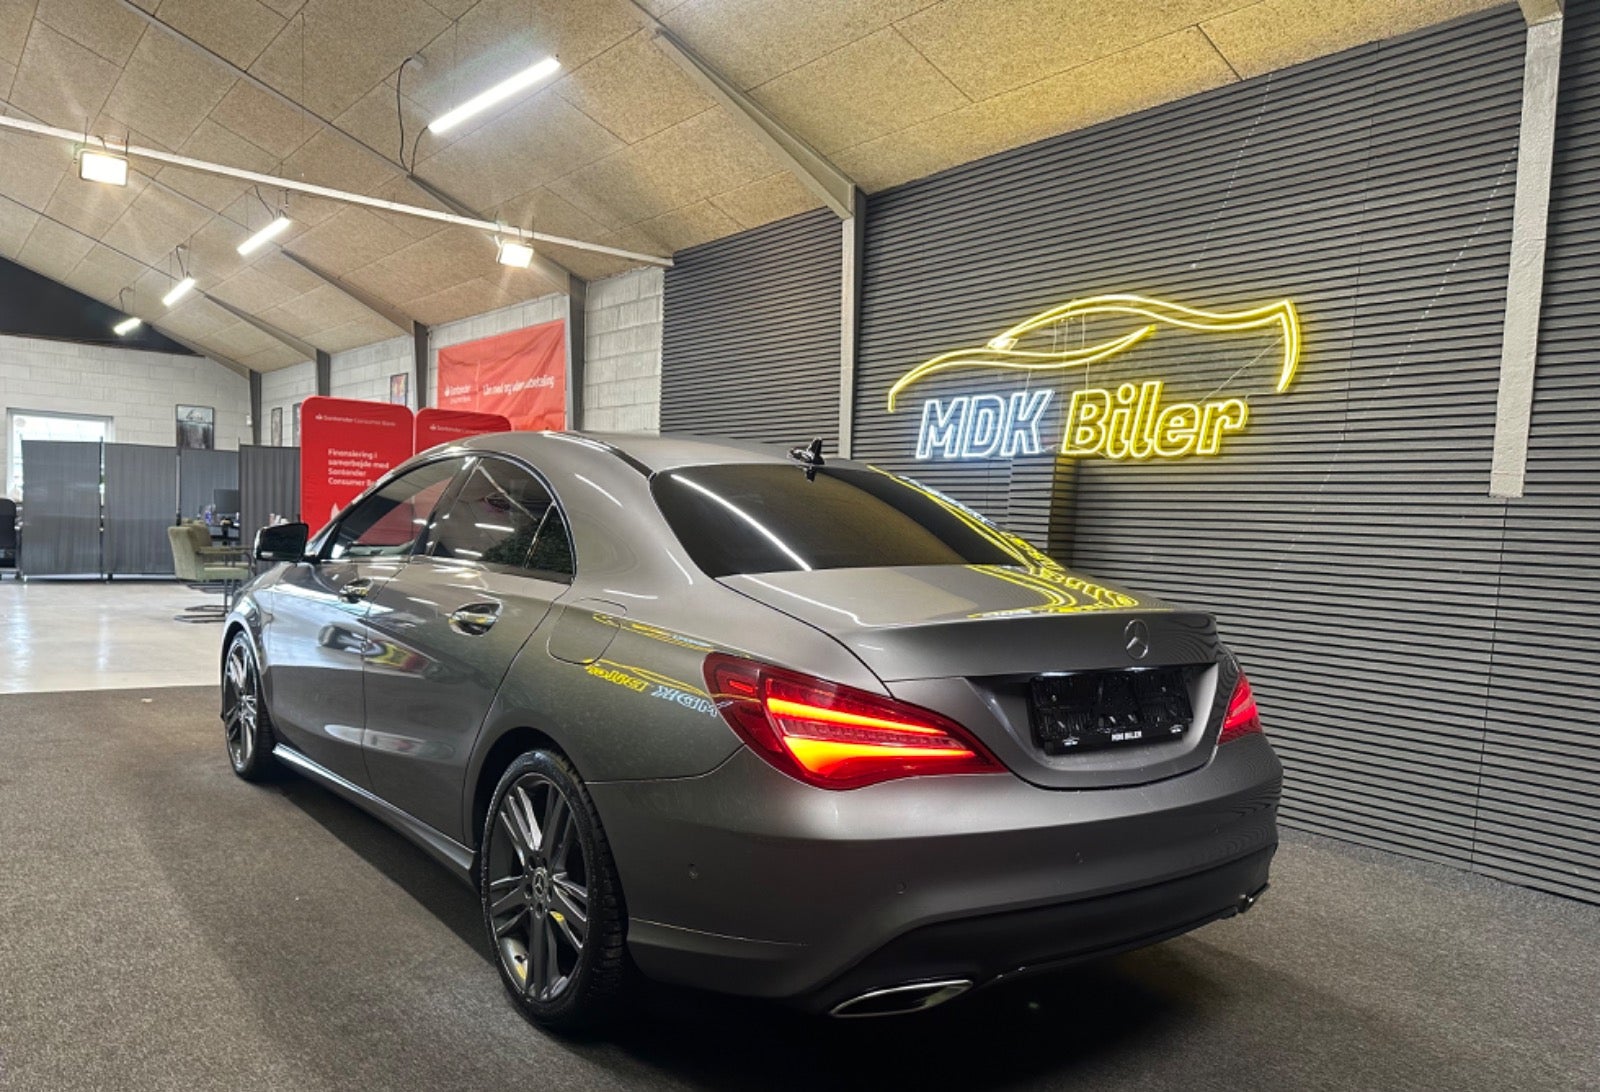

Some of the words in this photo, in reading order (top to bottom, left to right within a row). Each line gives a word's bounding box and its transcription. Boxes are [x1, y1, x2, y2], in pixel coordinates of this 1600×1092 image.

[324, 415, 353, 423] Santander
[915, 388, 1055, 460] MDK
[1061, 380, 1249, 460] Biler
[328, 448, 373, 460] Finansiering
[328, 459, 371, 469] samarbejde
[328, 467, 366, 477] Santander
[328, 477, 365, 486] Consumer
